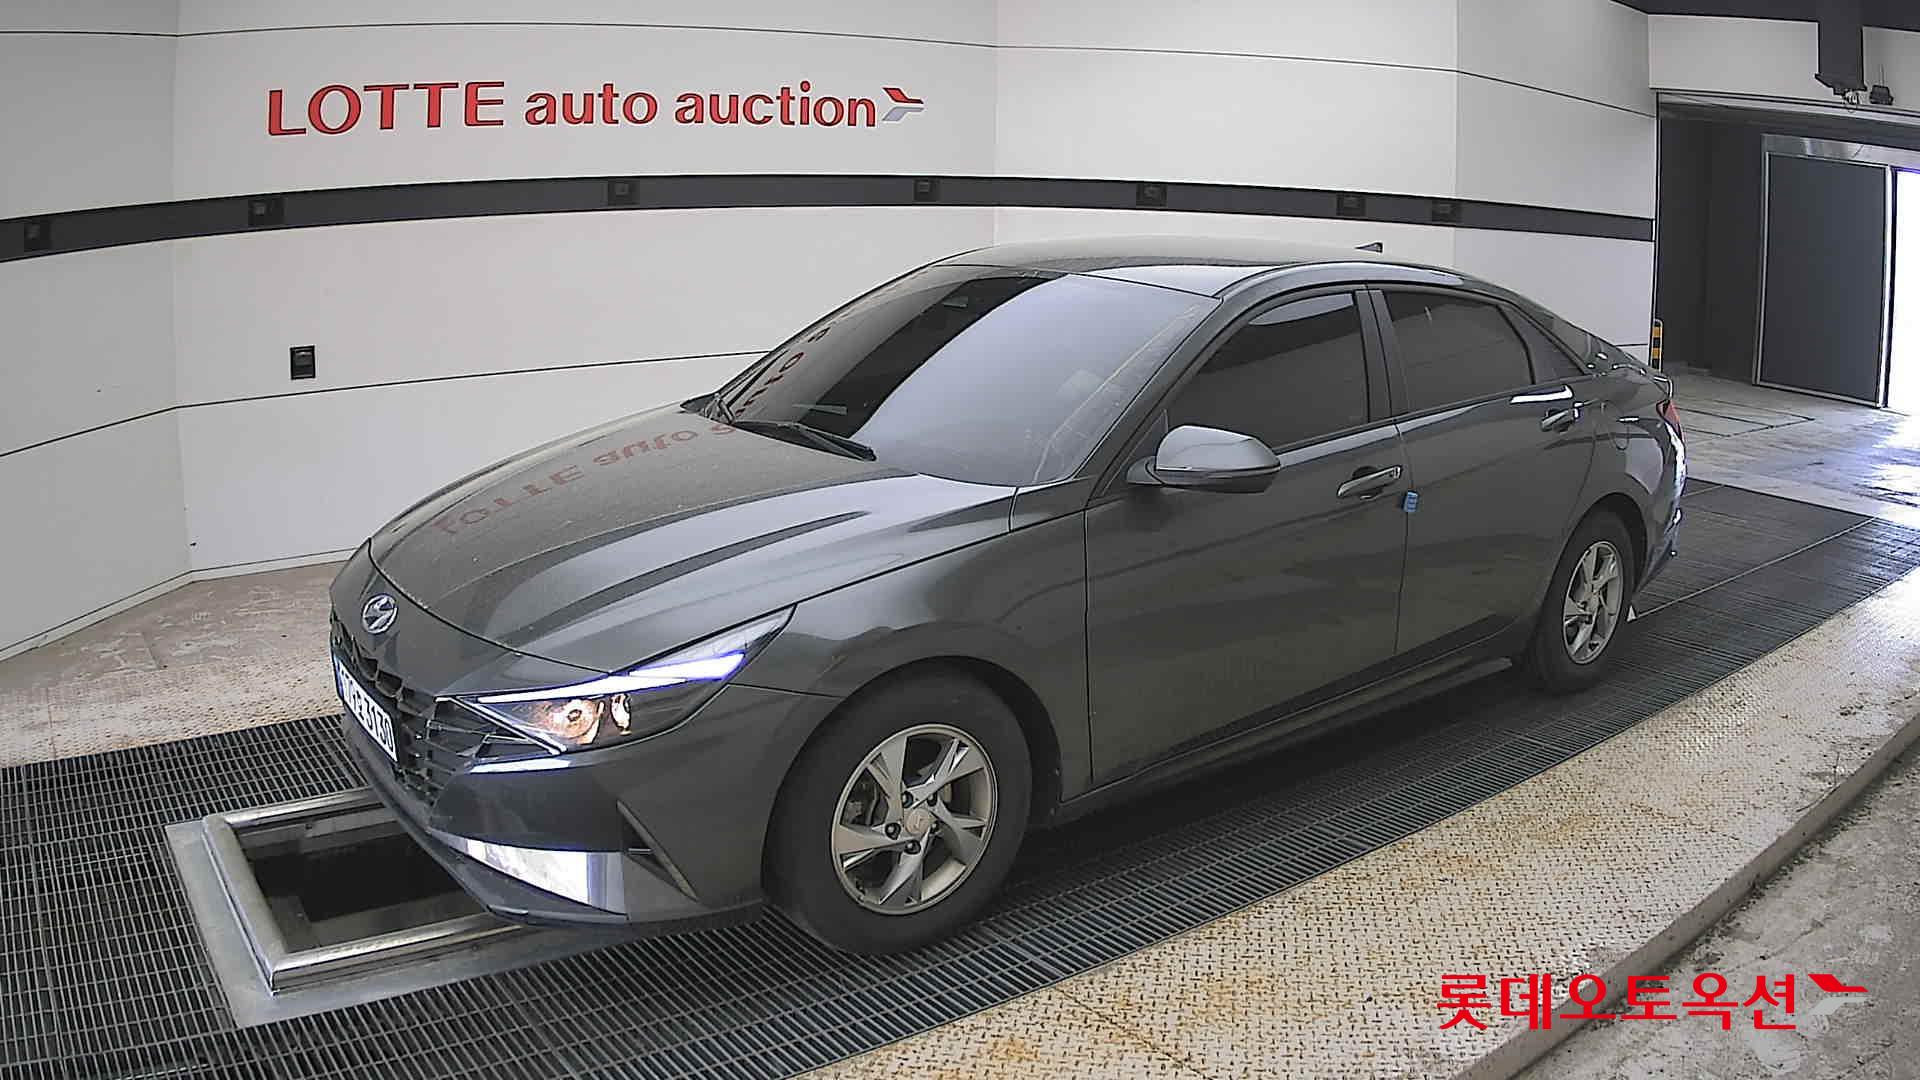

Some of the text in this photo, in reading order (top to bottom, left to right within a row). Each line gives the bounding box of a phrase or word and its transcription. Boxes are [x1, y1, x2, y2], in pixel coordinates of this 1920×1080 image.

[267, 80, 877, 136] LOTTE auto auction
